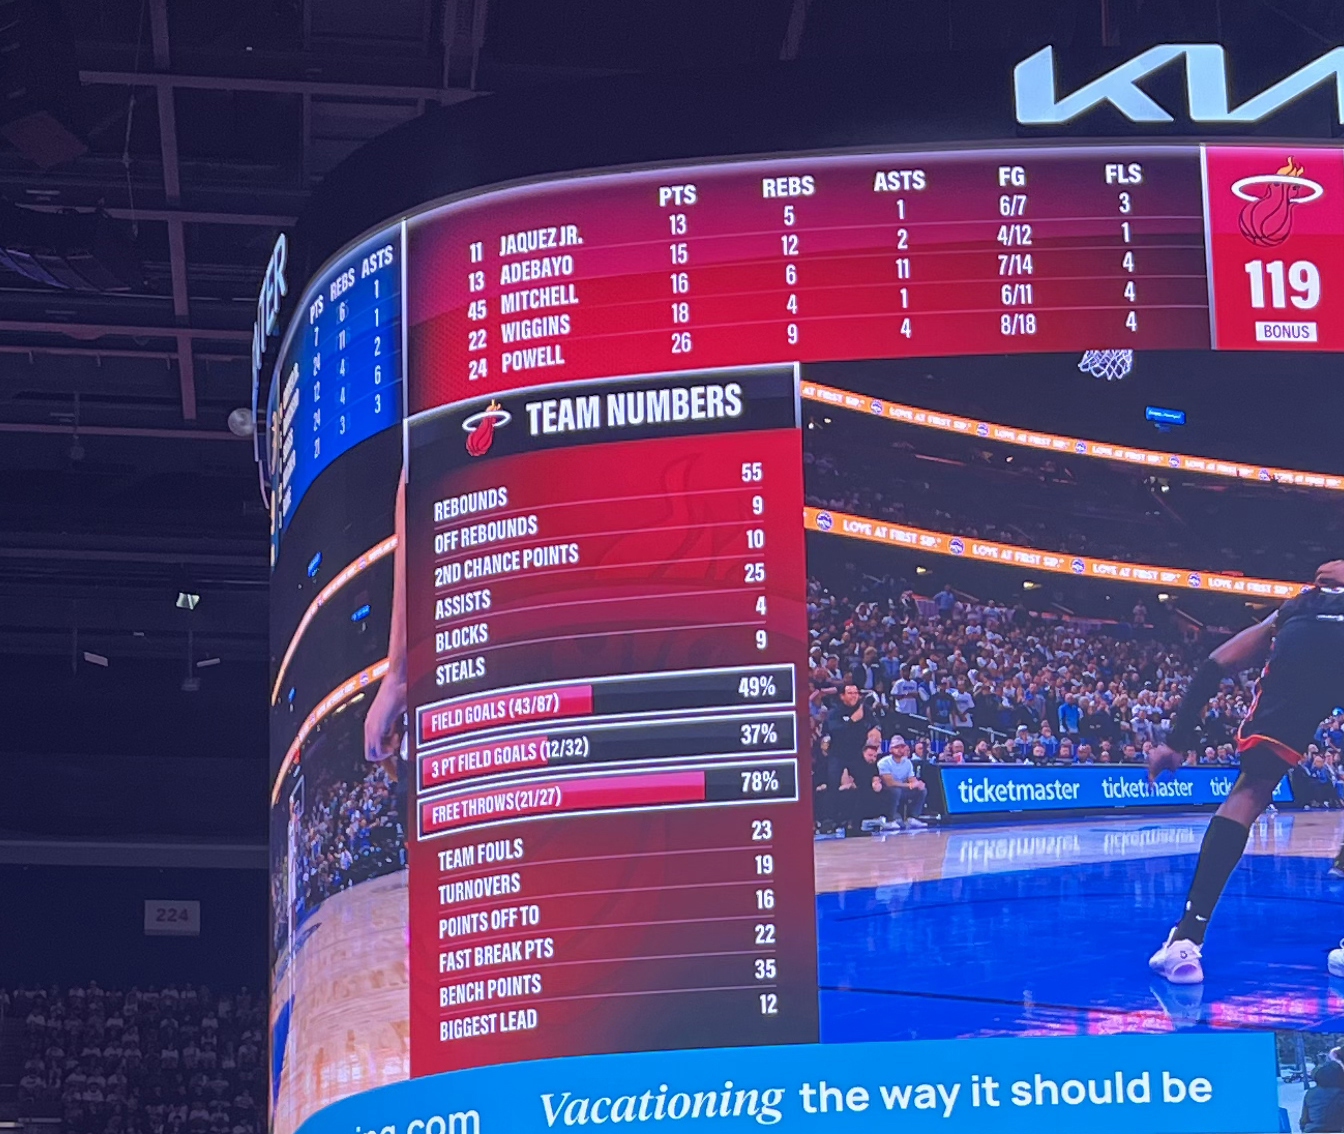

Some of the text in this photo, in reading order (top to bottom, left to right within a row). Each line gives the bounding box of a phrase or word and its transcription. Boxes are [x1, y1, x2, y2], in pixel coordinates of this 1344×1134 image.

[659, 163, 1142, 207] PTS REBS ASTS FG FLS
[469, 192, 1131, 263] 11 JAQUEZ JR. 13 5 1 6/7 3
[467, 251, 1135, 321] 45 MITCHELL 16 6 11 7/14 4
[468, 223, 1130, 293] 13 ADEBAYO 15 12 2 4/12 1
[1244, 260, 1321, 310] 119
[468, 281, 1136, 352] 22 WIGGINS 18 4 1 6/11 4
[1262, 323, 1312, 340] BONUS
[468, 311, 1137, 381] 24 POWELL 26 9 4 8/18 4
[525, 383, 742, 436] TEAM NUMBERS
[434, 462, 763, 522] REBOUNDS 55
[434, 495, 763, 555] OFF REBOUNDS 9
[434, 529, 764, 588] 2ND CHANCE POINTS 10
[434, 562, 765, 621] ASSISTS 25
[435, 595, 767, 653] BLOCKS 4
[435, 629, 767, 686] STEALS 9
[431, 675, 776, 732] FIELD GOALS (43/87) 49%
[957, 777, 1081, 803] ticketmaster
[156, 908, 188, 922] 224
[540, 1079, 786, 1129] Vacationing
[799, 1081, 870, 1114] the
[879, 1083, 961, 1118] way
[971, 1074, 1001, 1107] it
[1011, 1071, 1151, 1107] should
[1162, 1071, 1213, 1103] be
